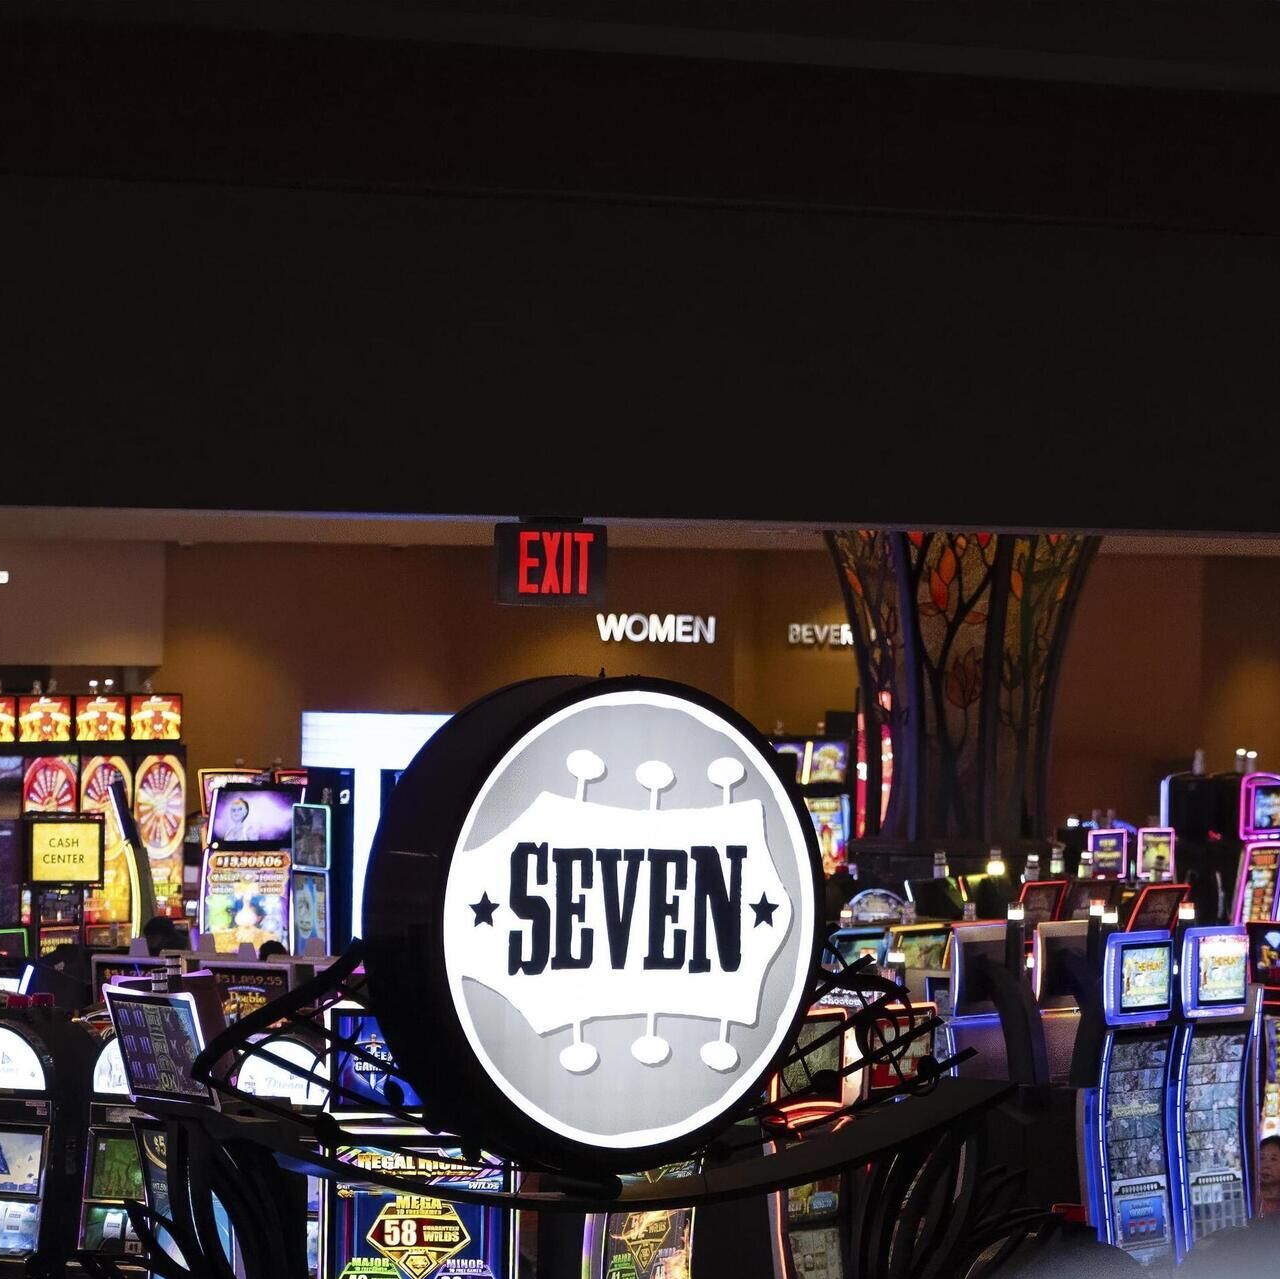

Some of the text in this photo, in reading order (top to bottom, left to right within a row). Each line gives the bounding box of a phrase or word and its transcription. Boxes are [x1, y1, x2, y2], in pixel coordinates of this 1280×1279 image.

[518, 531, 594, 596] EXIT
[597, 613, 716, 644] WOMEN
[49, 838, 79, 848] CASH
[42, 854, 84, 864] CENTER
[508, 842, 748, 975] SEVEN
[357, 1153, 415, 1171] REGAL
[468, 1181, 499, 1190] WILDS
[396, 1195, 442, 1209] MEGA
[384, 1219, 417, 1246] 58
[423, 1231, 460, 1242] WILDS
[351, 1257, 389, 1267] MAJOR
[446, 1259, 483, 1269] MINOR
